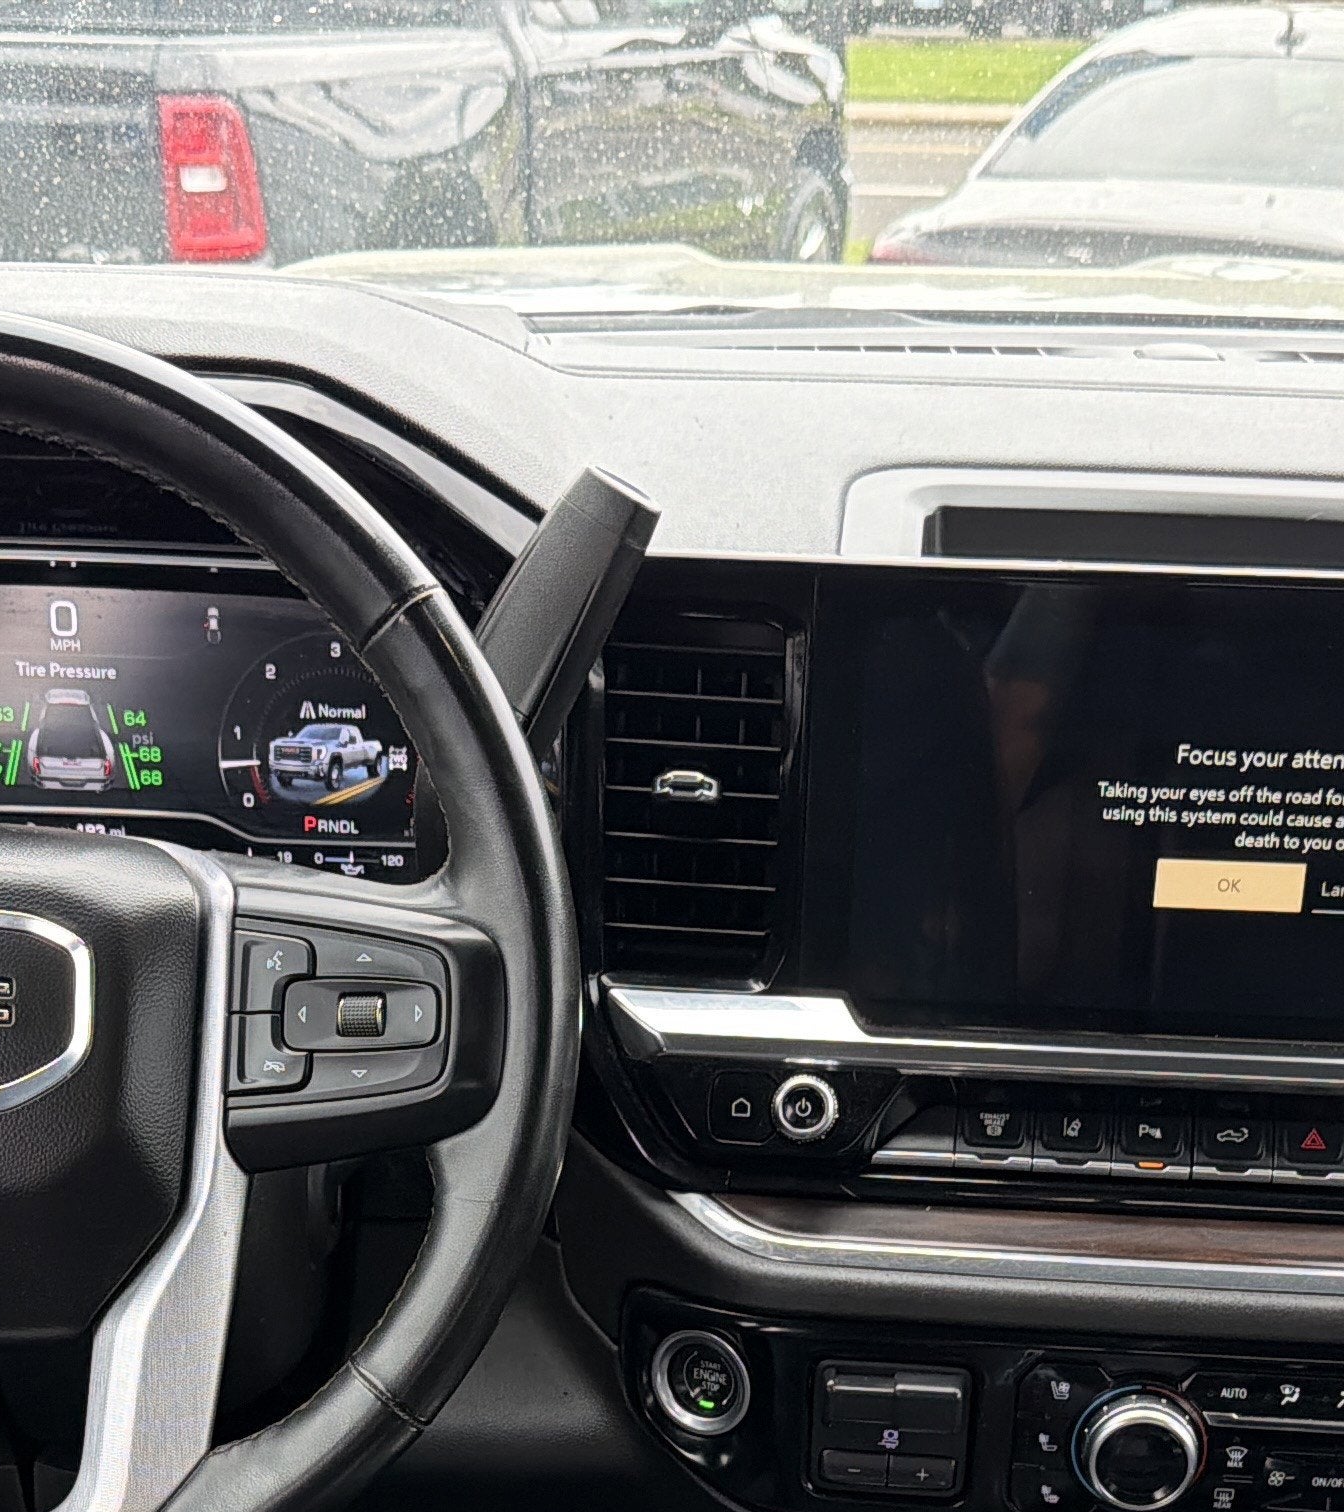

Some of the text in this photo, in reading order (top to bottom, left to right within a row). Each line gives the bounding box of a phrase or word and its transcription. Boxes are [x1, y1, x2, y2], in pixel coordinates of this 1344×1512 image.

[50, 600, 78, 637] 0
[50, 638, 81, 652] MPH
[330, 641, 341, 658] 3
[15, 661, 117, 680] Tire Pressure
[265, 663, 276, 679] 2
[123, 710, 147, 727] 64
[318, 703, 367, 720] Normal
[132, 732, 154, 748] psi
[233, 725, 241, 741] 1
[138, 747, 162, 763] 68
[1177, 744, 1237, 767] Focus
[1240, 751, 1288, 772] your
[140, 770, 163, 787] 68
[242, 792, 255, 808] 0
[1097, 781, 1148, 804] Taking
[1150, 788, 1187, 803] your
[1189, 790, 1226, 806] eyes
[1228, 785, 1255, 803] off
[1256, 786, 1281, 804] the
[1285, 788, 1323, 806] road
[1102, 805, 1146, 826] using
[1148, 806, 1178, 823] this
[1180, 808, 1237, 828] system
[1239, 809, 1284, 827] could
[1286, 813, 1332, 829] cause
[1335, 815, 1344, 829] a
[1234, 831, 1281, 849] death
[1283, 834, 1300, 850] to
[1302, 838, 1332, 854] you
[314, 852, 324, 865] 0
[381, 854, 404, 867] 120
[1217, 878, 1241, 893] OK
[700, 1360, 721, 1371] START
[693, 1367, 727, 1386] ENGINE
[701, 1381, 720, 1392] STOP
[1220, 1387, 1248, 1400] AUTO
